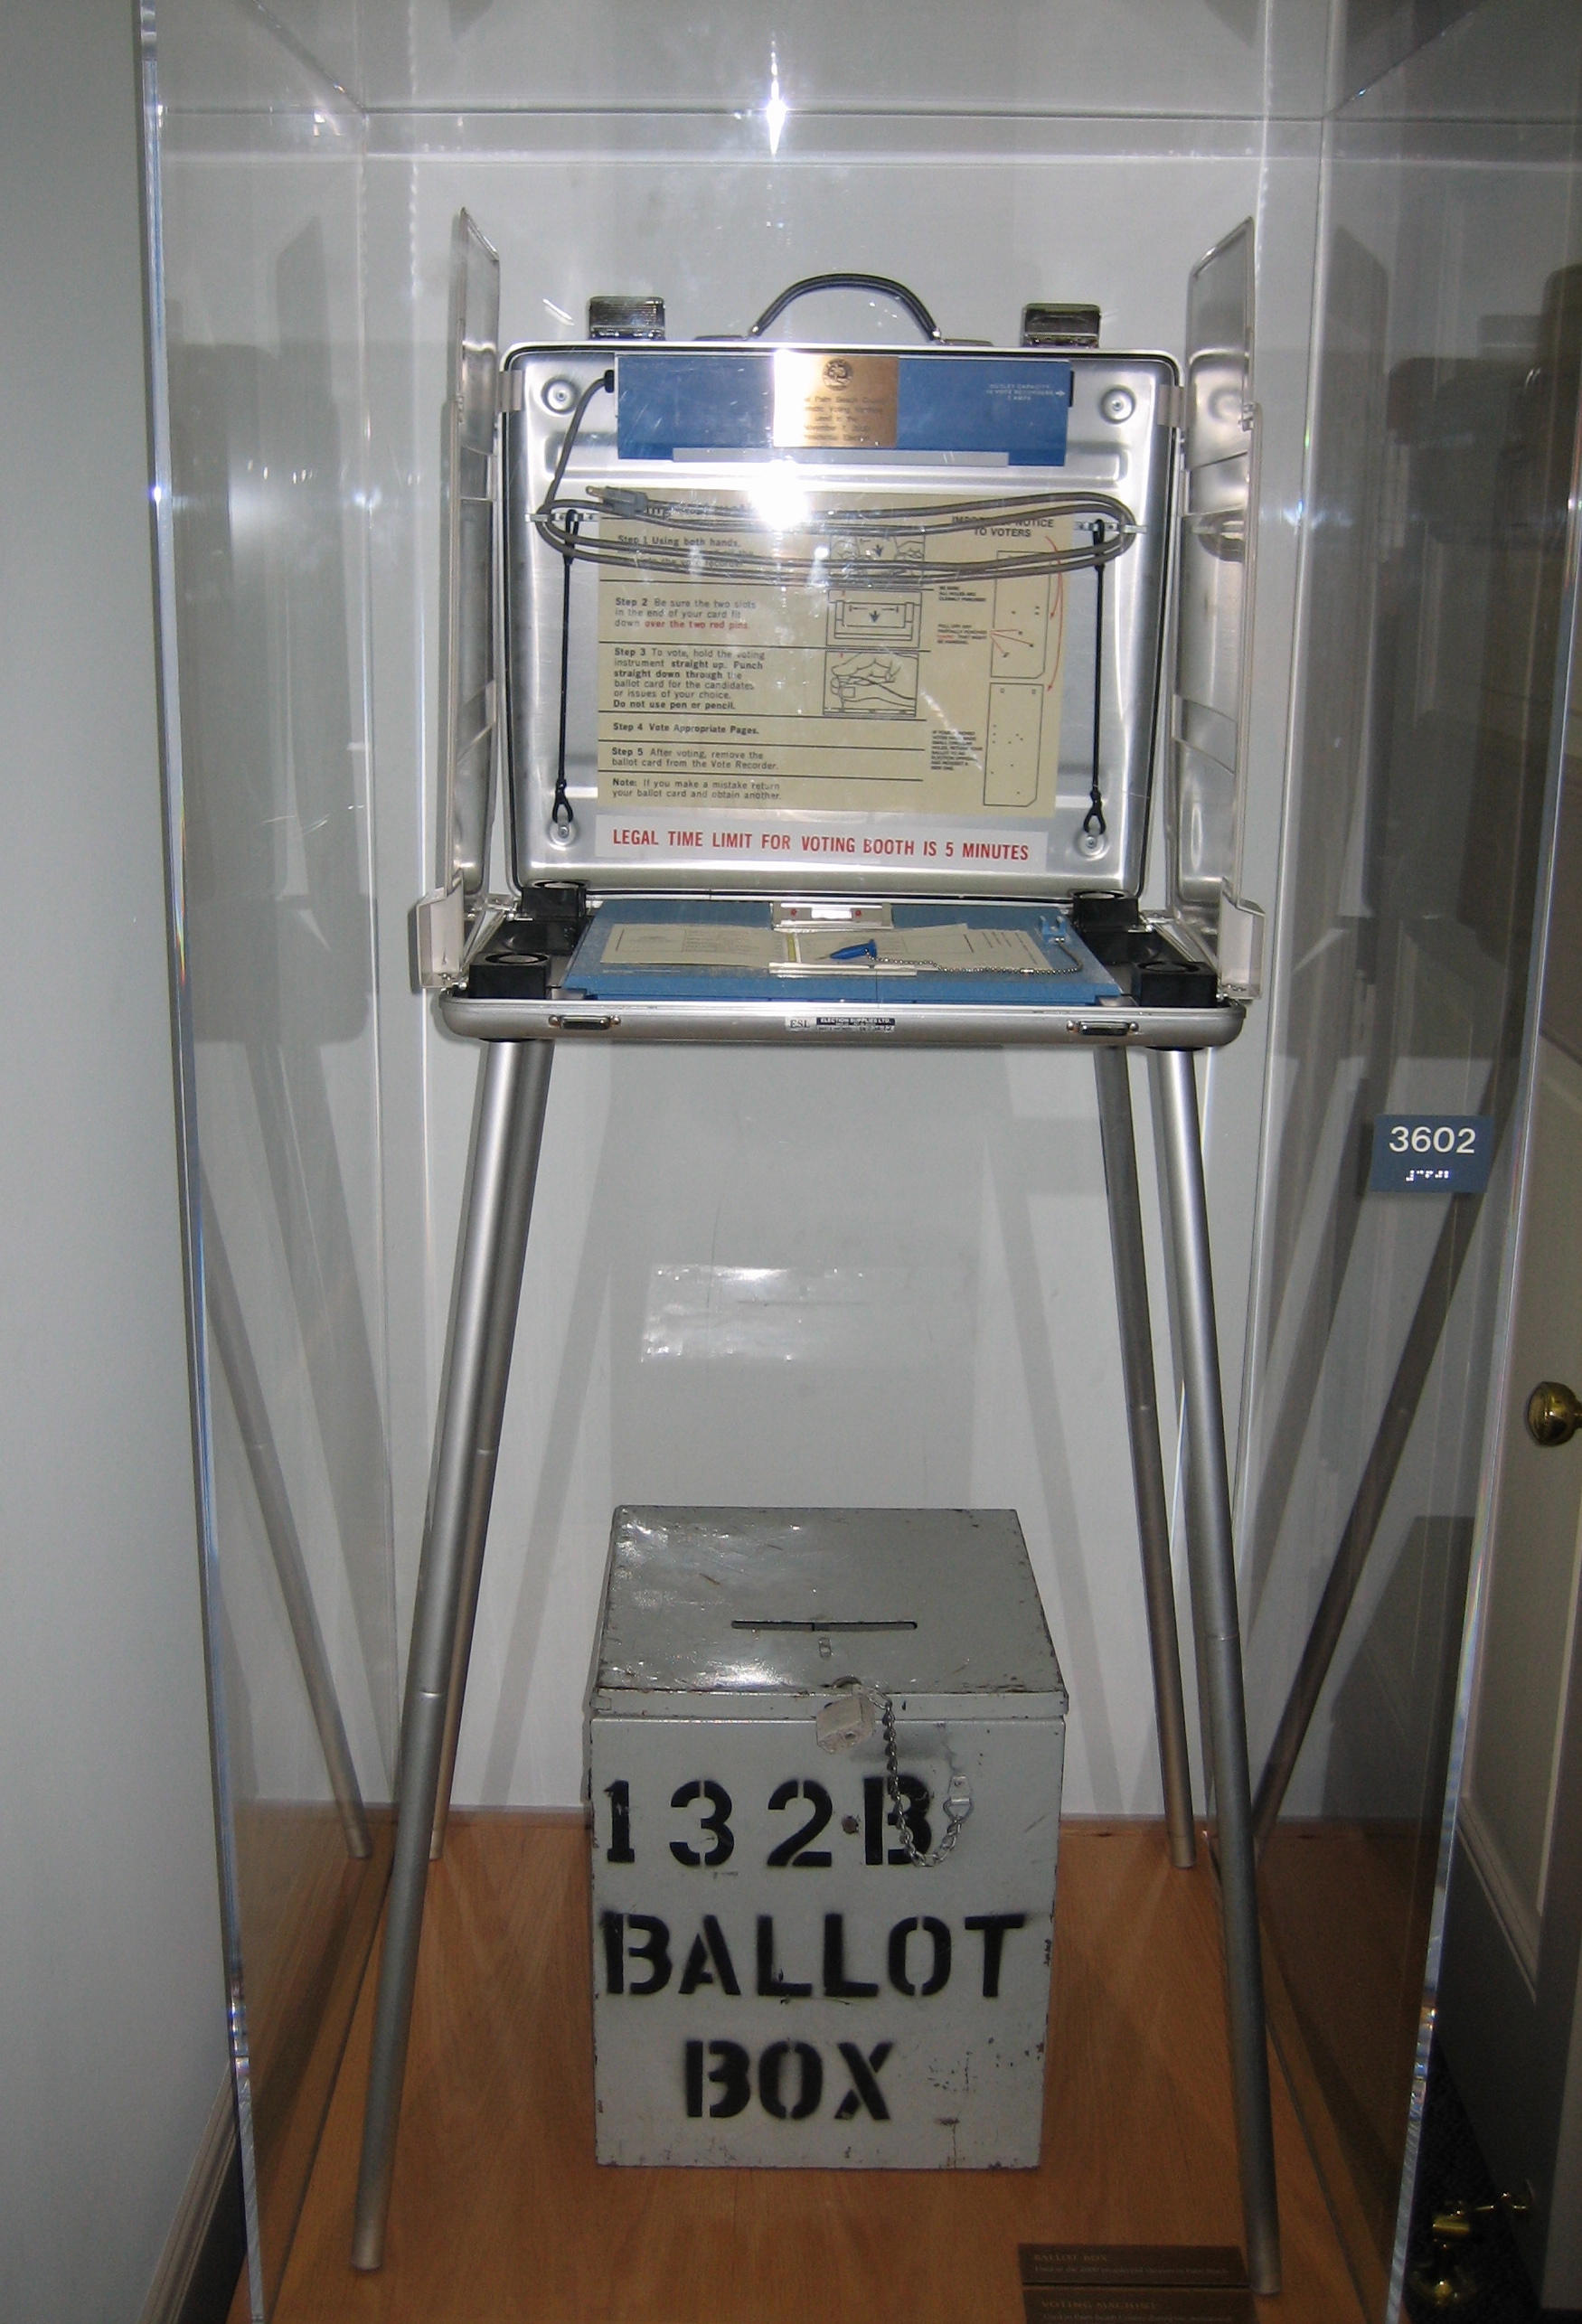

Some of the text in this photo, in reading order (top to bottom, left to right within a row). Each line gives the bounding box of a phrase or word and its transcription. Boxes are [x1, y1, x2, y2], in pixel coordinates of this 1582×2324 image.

[975, 529, 1031, 538] TO VOTERS
[617, 534, 640, 545] Step
[652, 536, 679, 548] Using
[683, 536, 706, 546] both
[615, 597, 757, 609] Step 2 Be sure the two slots
[615, 608, 624, 617] in
[627, 608, 643, 617] the
[646, 608, 664, 618] end
[668, 609, 678, 618] of
[681, 611, 702, 621] your
[707, 610, 728, 619] card
[615, 618, 640, 627] down
[645, 620, 665, 628] over
[669, 619, 684, 629] the
[688, 620, 706, 629] two
[709, 620, 725, 629] red
[614, 647, 636, 658] Step
[640, 648, 646, 656] 3
[652, 647, 664, 657] To
[692, 648, 713, 658] hold
[717, 649, 732, 658] the
[614, 658, 664, 668] instrument
[671, 659, 709, 671] straight
[733, 661, 763, 670] Punch
[614, 669, 651, 680] straight
[655, 670, 681, 678] down
[685, 671, 723, 681] through
[614, 679, 640, 688] ballot
[644, 680, 664, 689] card
[668, 680, 682, 689] for
[685, 681, 701, 690] the
[627, 689, 656, 698] issues
[661, 690, 671, 698] of
[673, 692, 694, 701] your
[613, 699, 736, 711] Do not use pen or pencil.
[613, 722, 759, 735] Step 4 Vote Appropriate Pages.
[612, 747, 633, 757] Step
[636, 748, 644, 756] 5
[650, 748, 672, 757] After
[711, 751, 745, 759] remove
[749, 751, 764, 760] the
[612, 757, 637, 767] ballot
[641, 757, 662, 767] card
[666, 758, 687, 767] from
[692, 759, 707, 768] the
[711, 759, 731, 768] Vote
[612, 777, 637, 786] Note:
[643, 778, 650, 787] If
[654, 780, 670, 789] you
[674, 779, 699, 789] make
[702, 781, 708, 789] a
[712, 780, 749, 790] mistake
[612, 790, 633, 799] your
[636, 788, 662, 798] ballot
[666, 788, 687, 799] card
[691, 789, 708, 798] and
[711, 790, 740, 800] obtain
[613, 828, 1029, 861] LEGAL TIME LIMIT FOR VOTING BOOTH IS 5 MINUTES
[789, 1019, 811, 1030] ESL
[1389, 1125, 1476, 1154] 3602
[601, 1910, 1029, 1998] BALLOT
[684, 2039, 895, 2121] BOX
